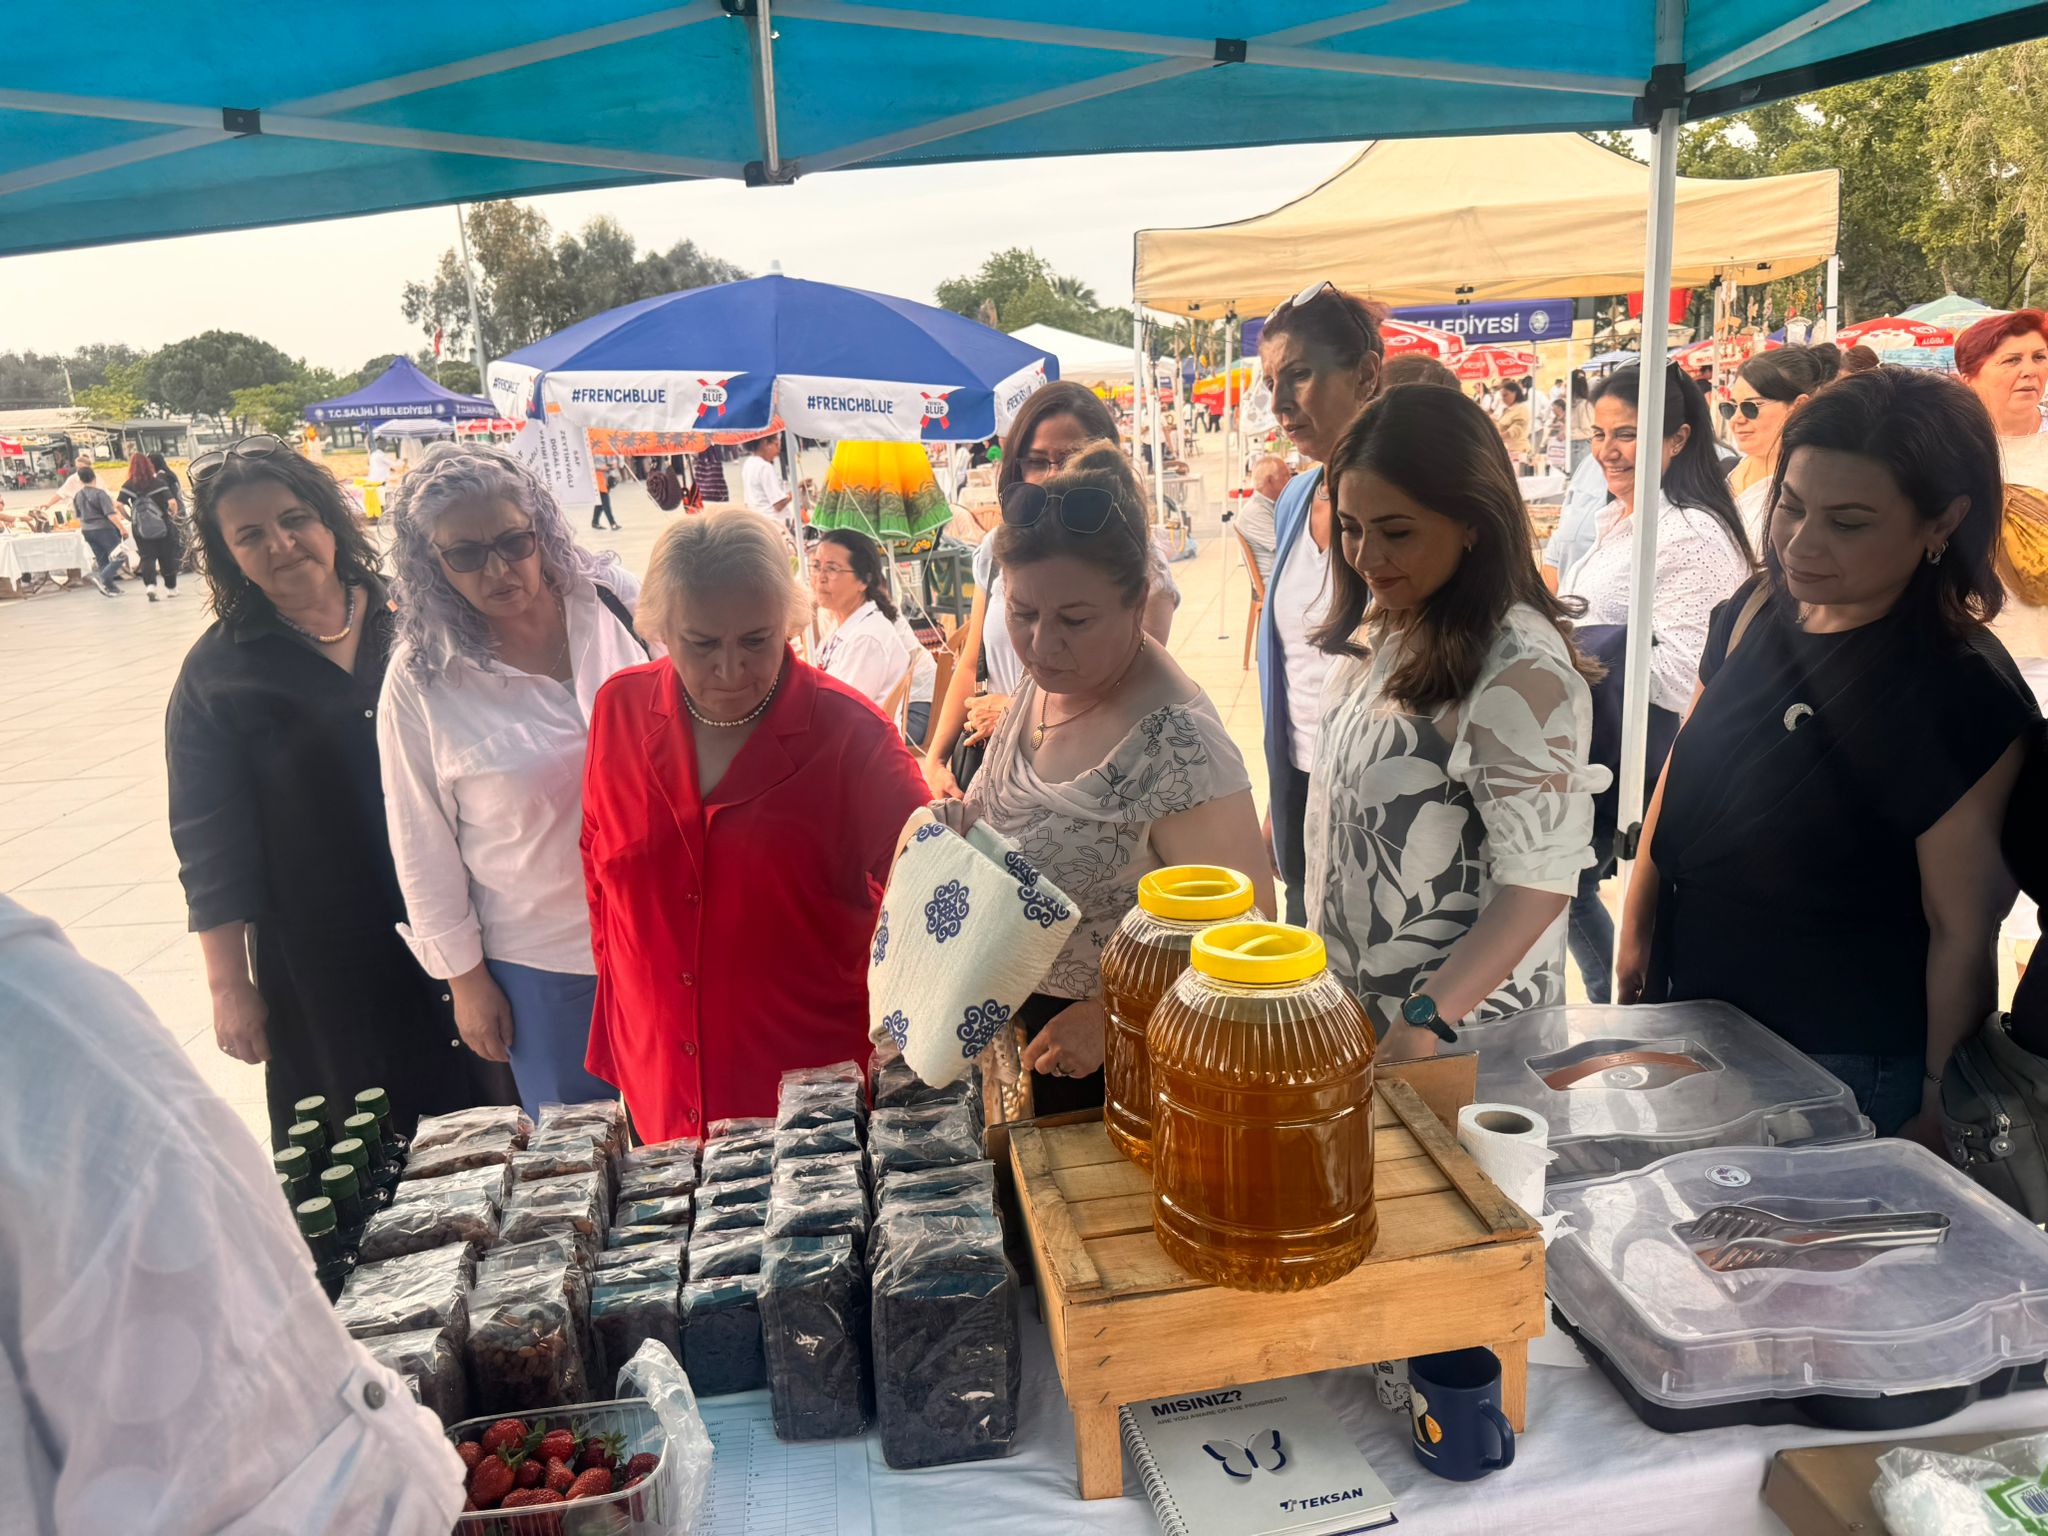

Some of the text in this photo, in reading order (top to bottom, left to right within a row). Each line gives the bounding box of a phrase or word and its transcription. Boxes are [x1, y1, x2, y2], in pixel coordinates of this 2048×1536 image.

[1410, 313, 1520, 335] EDİYESİ
[571, 388, 667, 404] #FRENCHBLUE
[702, 392, 723, 402] BLUE
[380, 404, 433, 416] BELEDİYESİ
[807, 395, 894, 414] #FRENCHBLUE
[925, 405, 945, 415] BLUE
[1151, 1390, 1242, 1417] MISINIZ?
[1157, 1417, 1173, 1425] ARE
[1190, 1410, 1216, 1419] AWARE
[1299, 1487, 1363, 1510] TEKSAN
